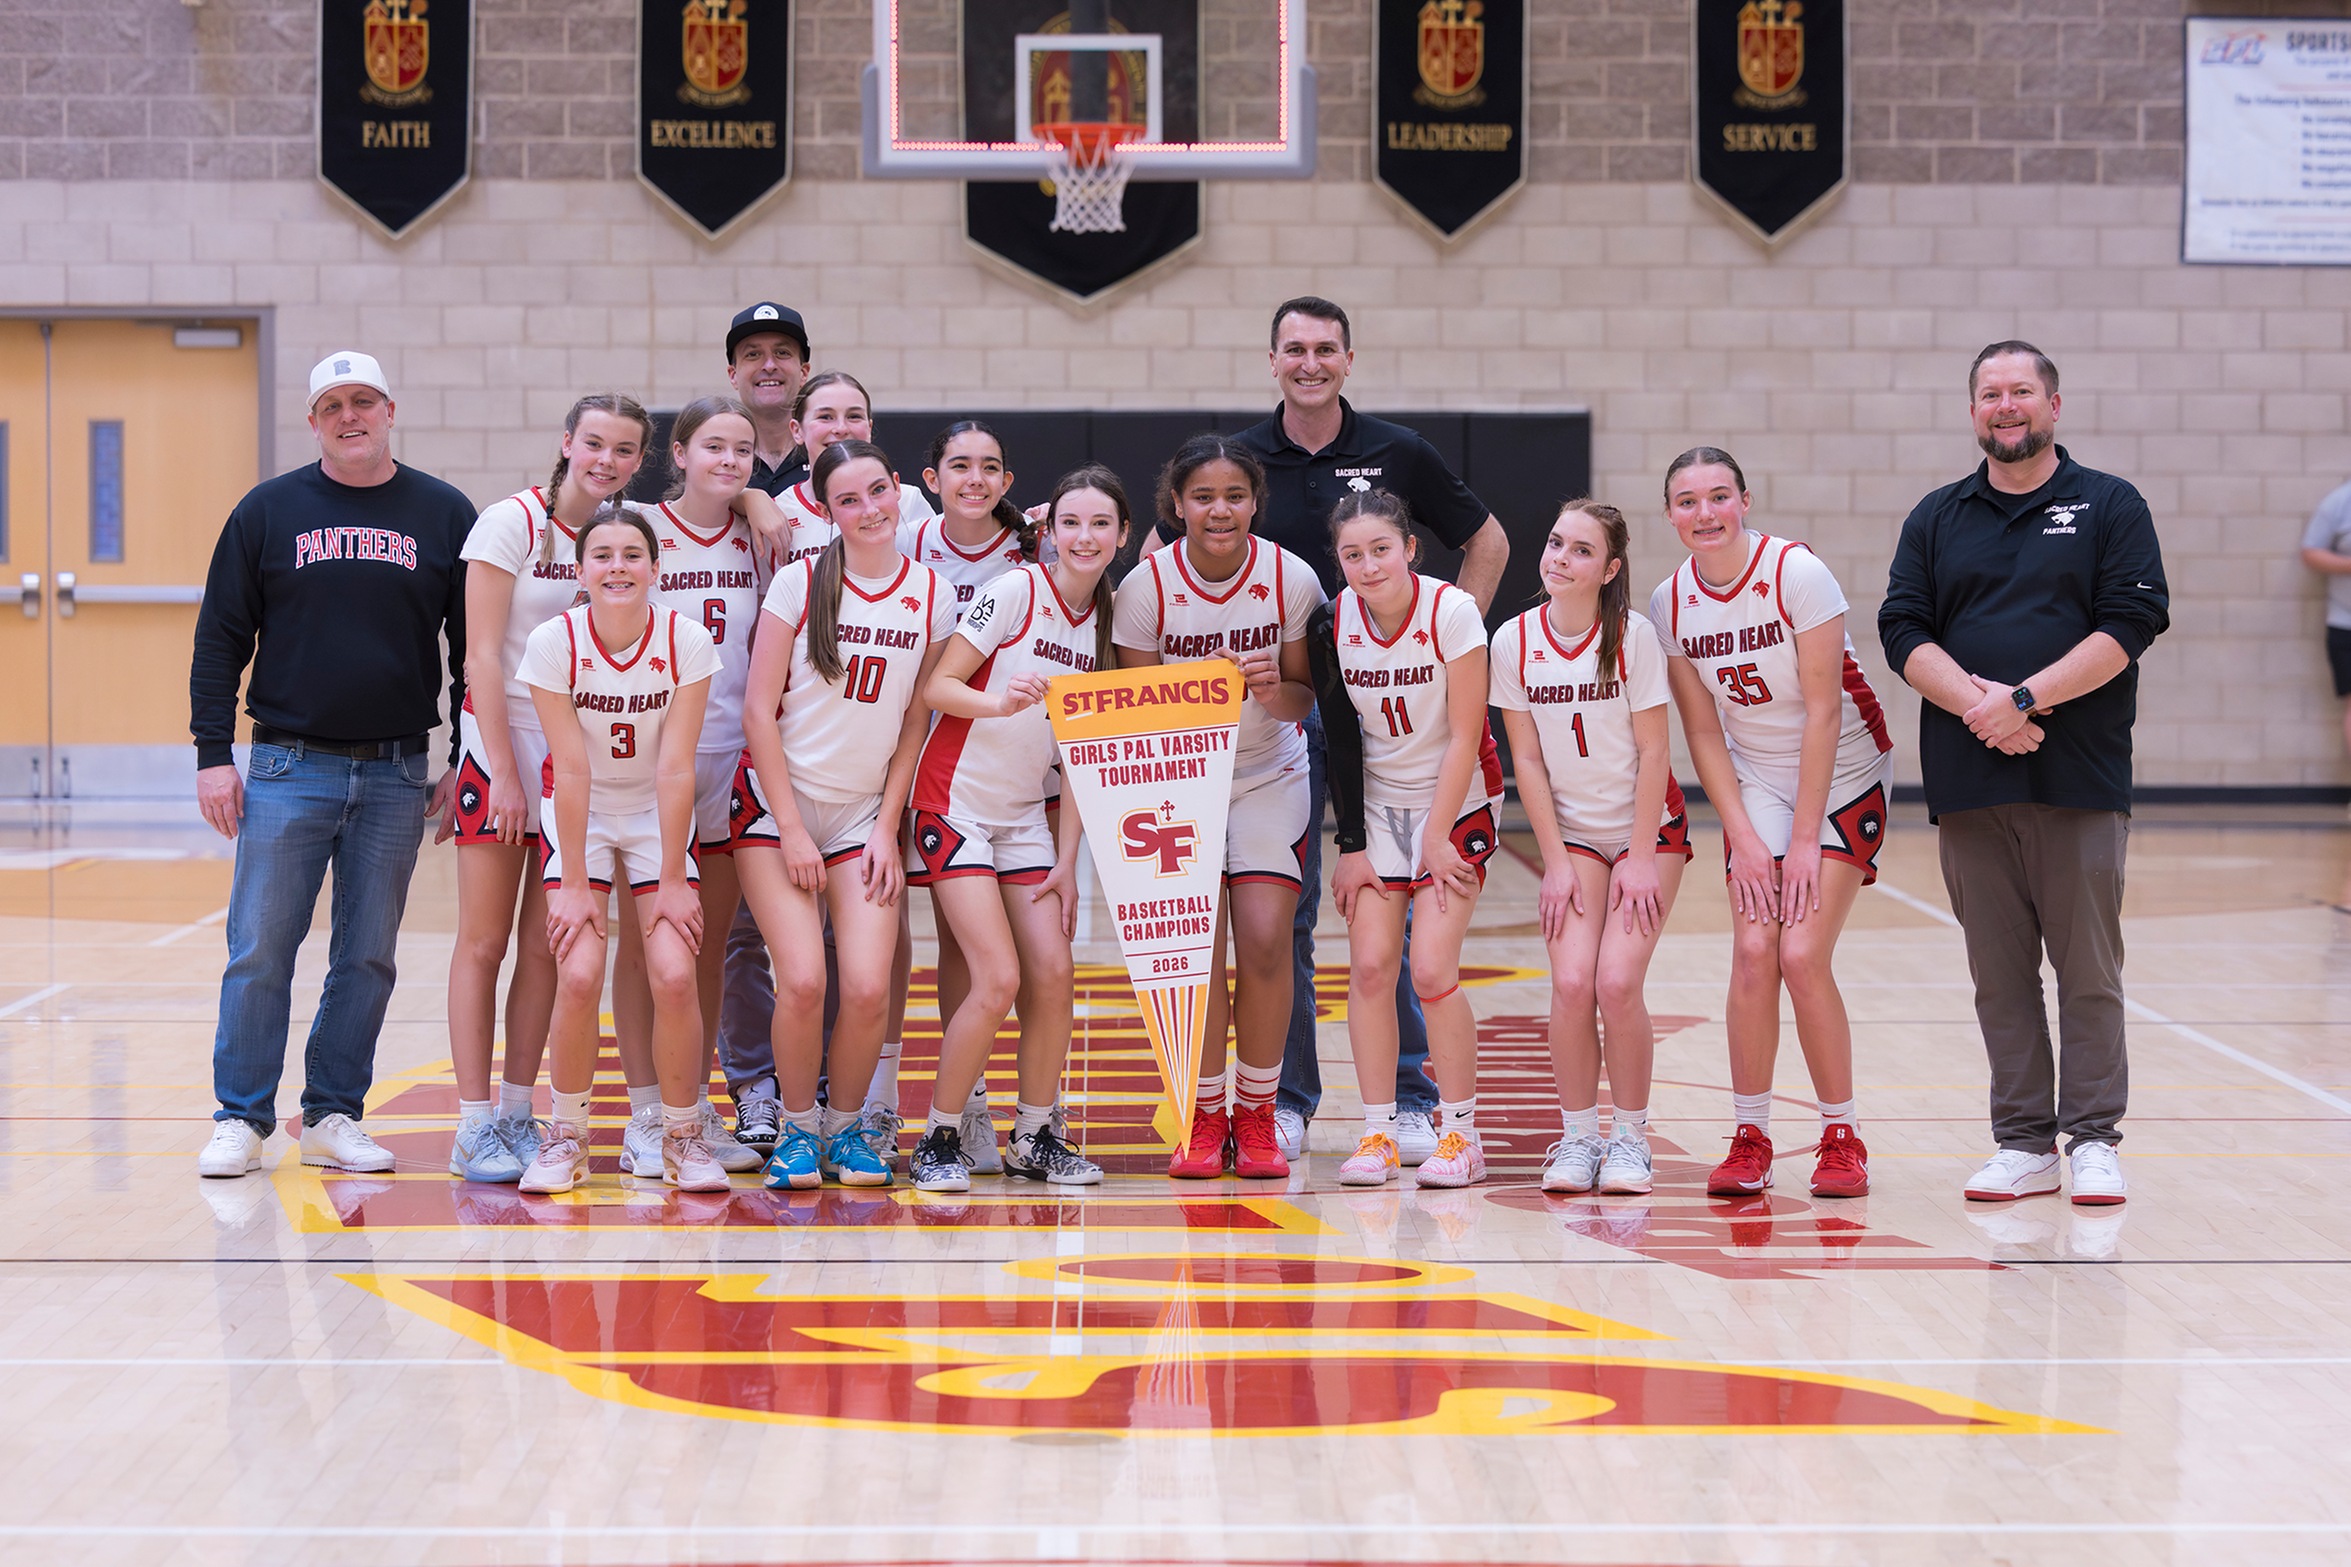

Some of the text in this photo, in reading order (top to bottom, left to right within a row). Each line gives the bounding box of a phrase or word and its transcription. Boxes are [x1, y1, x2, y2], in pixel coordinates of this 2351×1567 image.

[362, 120, 431, 149] FAITH
[651, 119, 777, 149] EXCELLENCE
[1387, 121, 1513, 152] LEADERSHIP
[1722, 122, 1818, 153] SERVICE
[1335, 467, 1382, 477] SACRED HEART
[2042, 526, 2077, 535] PANTHERS
[296, 526, 417, 571] PANTHERS
[660, 571, 753, 592] SACRED HEART
[703, 598, 726, 645] 6
[836, 624, 919, 651] CRED HEART
[1164, 622, 1279, 657] SACRED HEART
[1682, 620, 1784, 659] SACRED HEART
[1034, 638, 1096, 673] SACRED HEA
[843, 654, 887, 704] 10
[1343, 664, 1434, 688] SACRED HEART
[1717, 663, 1773, 707] 35
[575, 689, 670, 714] SACRED HEART
[1526, 680, 1620, 705] SACRED HEART
[1381, 696, 1414, 737] 11
[611, 722, 636, 759] 3
[1069, 730, 1230, 766] GIRLS PAL VARSITY
[1571, 712, 1589, 757] 1
[1098, 757, 1207, 788] TOURNAMENT
[1121, 810, 1198, 876] SF
[1117, 895, 1212, 922] BASKETBALL
[1123, 916, 1211, 942] CHAMPIONS
[1152, 956, 1189, 973] 2026
